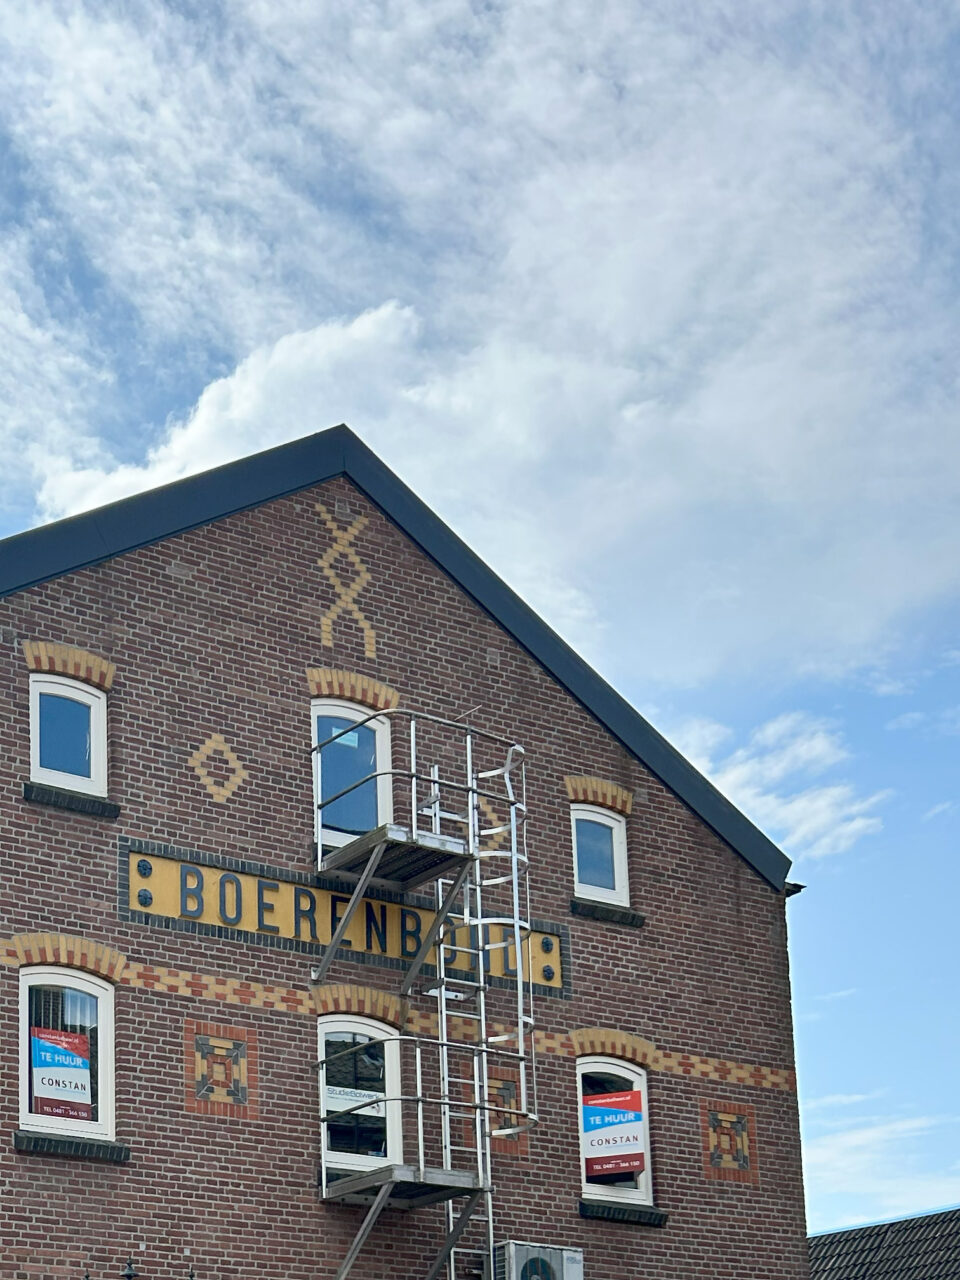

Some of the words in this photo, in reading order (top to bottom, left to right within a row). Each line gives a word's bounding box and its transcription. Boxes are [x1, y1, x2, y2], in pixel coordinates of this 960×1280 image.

[40, 1052, 52, 1062] TE
[54, 1054, 83, 1067] HUUR
[41, 1077, 87, 1091] CONSTAN
[589, 1115, 602, 1125] TE
[604, 1112, 635, 1123] HUUR
[590, 1135, 639, 1146] CONSTAN
